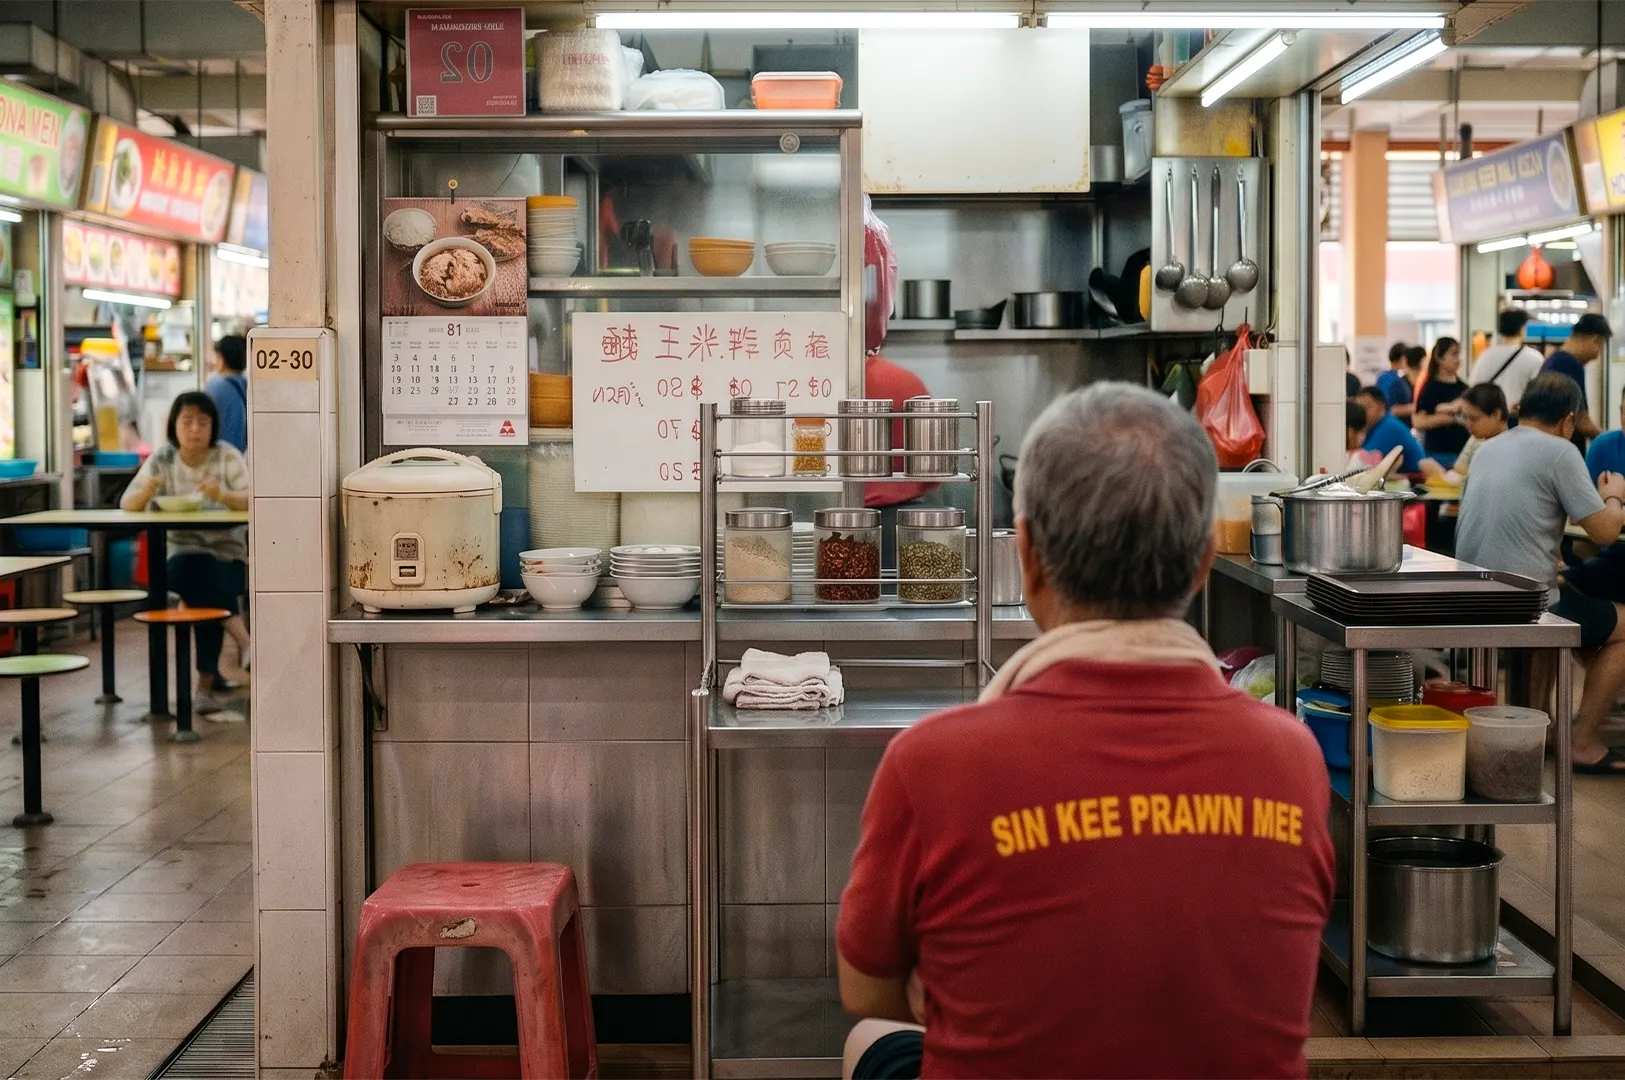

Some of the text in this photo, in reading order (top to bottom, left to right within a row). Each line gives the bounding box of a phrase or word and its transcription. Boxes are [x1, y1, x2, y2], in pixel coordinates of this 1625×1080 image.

[447, 323, 461, 337] 81
[256, 349, 313, 370] 02-30
[991, 794, 1304, 857] SIN KEE PRAWN MEE
